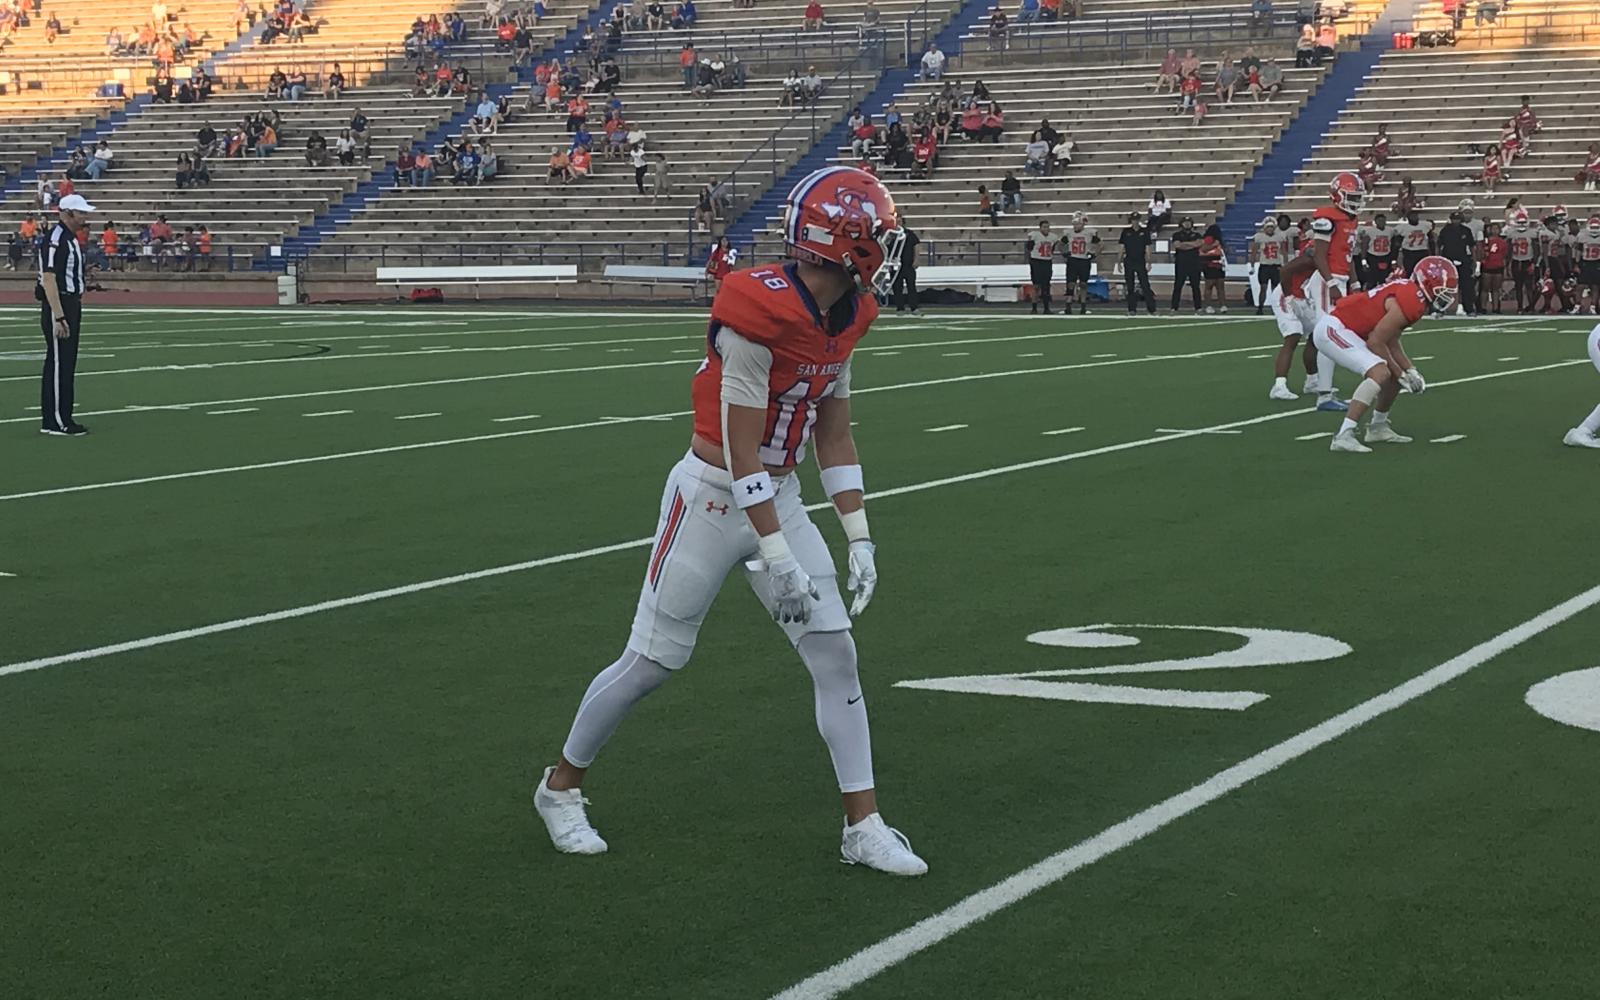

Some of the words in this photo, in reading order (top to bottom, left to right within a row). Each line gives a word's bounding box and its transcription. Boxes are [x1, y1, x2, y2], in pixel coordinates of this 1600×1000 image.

[1071, 240, 1086, 254] 60
[750, 270, 789, 291] 18
[797, 363, 819, 376] SAN
